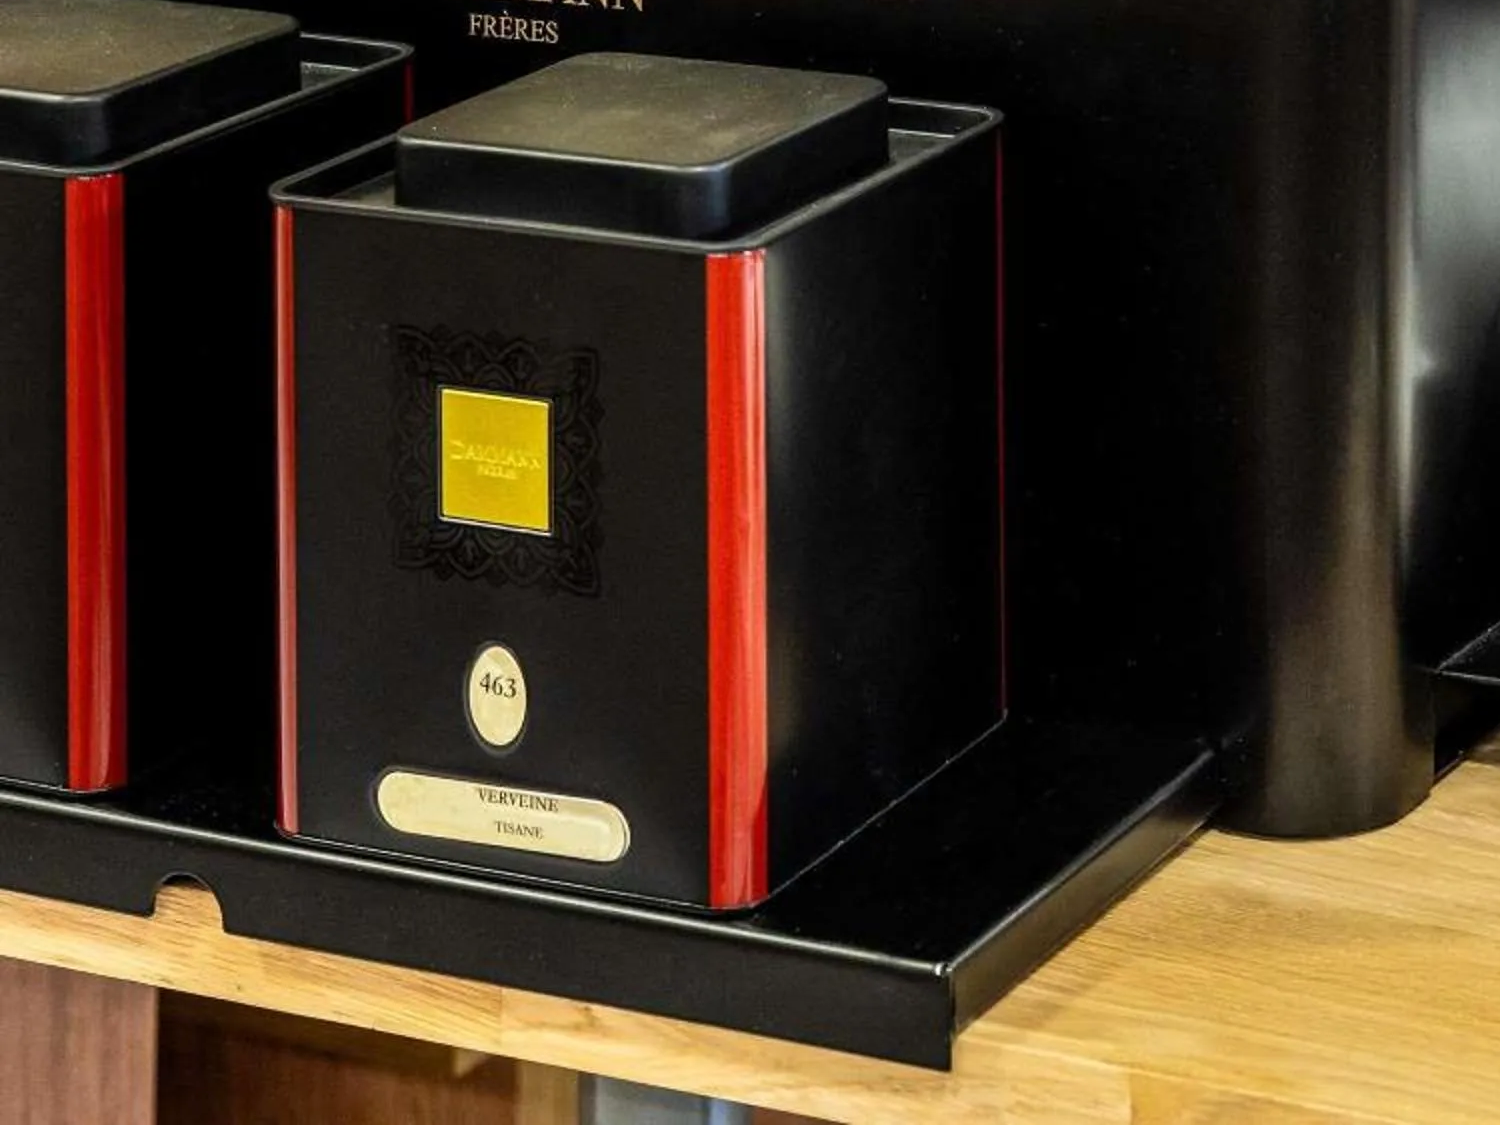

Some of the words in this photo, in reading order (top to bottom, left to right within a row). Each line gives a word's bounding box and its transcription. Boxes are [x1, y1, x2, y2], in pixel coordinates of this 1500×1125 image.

[467, 10, 560, 44] FRÈRES
[479, 671, 517, 699] 463
[478, 787, 560, 813] VERVEINE
[494, 819, 545, 840] TISANE
